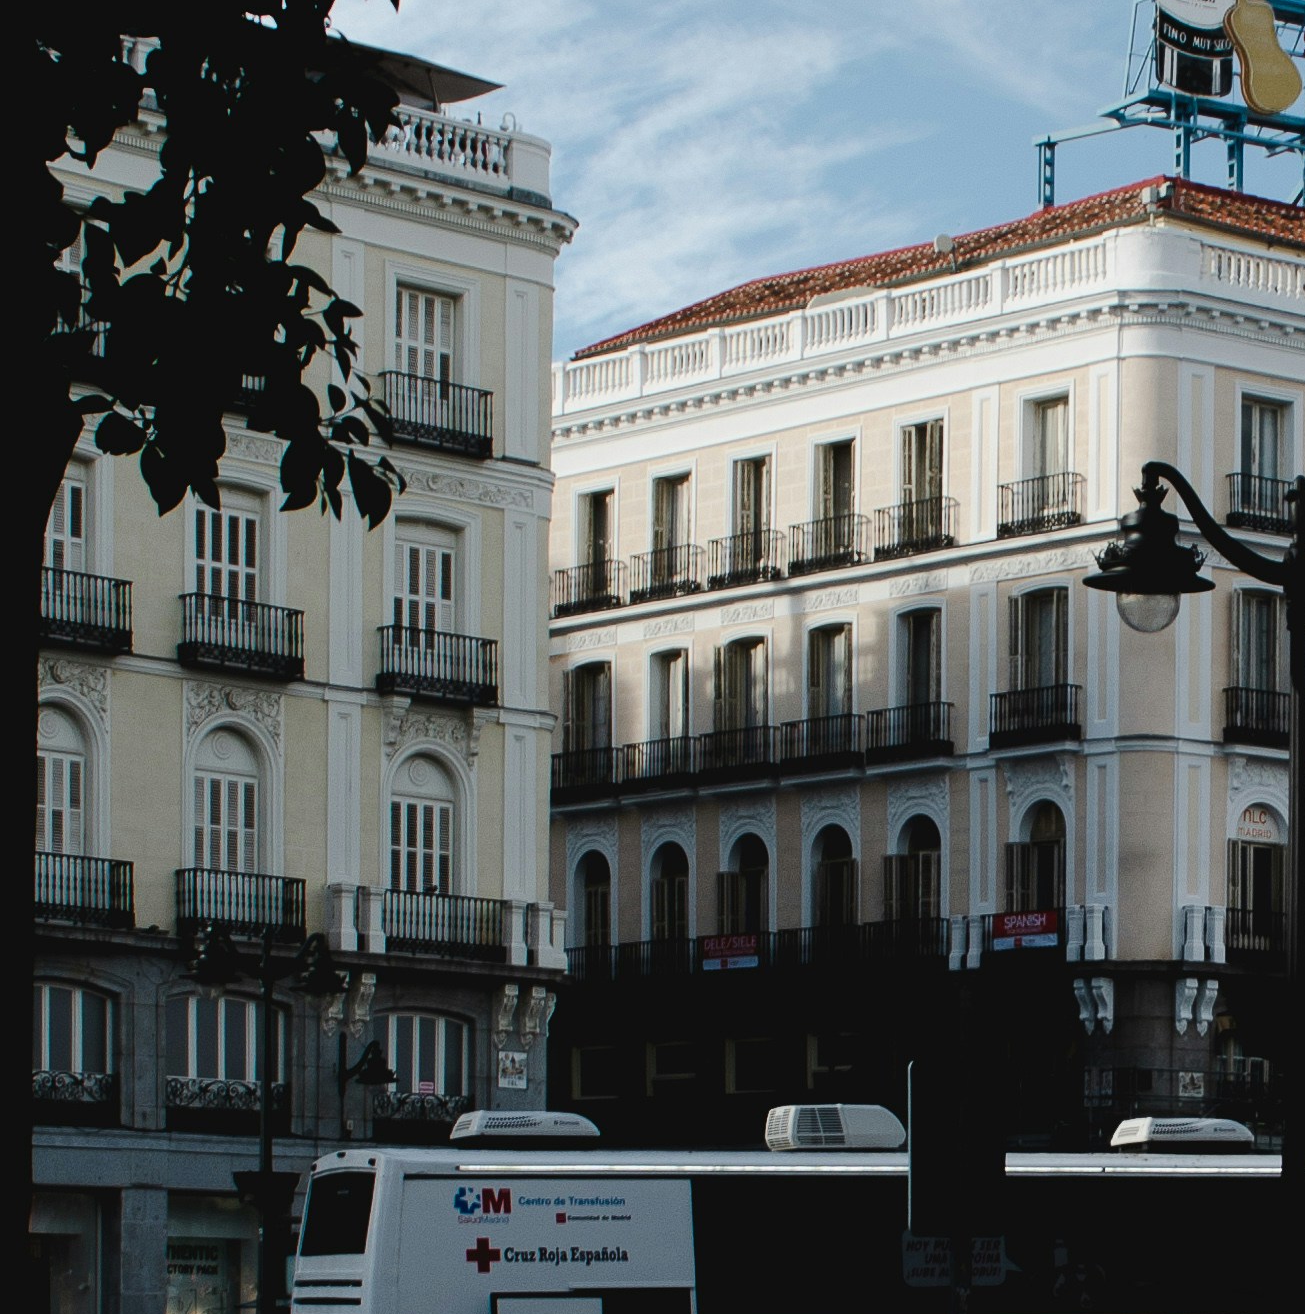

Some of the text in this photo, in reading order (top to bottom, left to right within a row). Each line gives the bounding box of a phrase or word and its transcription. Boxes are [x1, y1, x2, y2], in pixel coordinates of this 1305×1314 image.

[1163, 23, 1187, 43] FINO
[1004, 913, 1046, 929] SPANISH
[704, 935, 757, 951] DELE/SIELE
[518, 1195, 626, 1206] Centro de Transfusión
[504, 1246, 629, 1266] Cruz Roja Española
